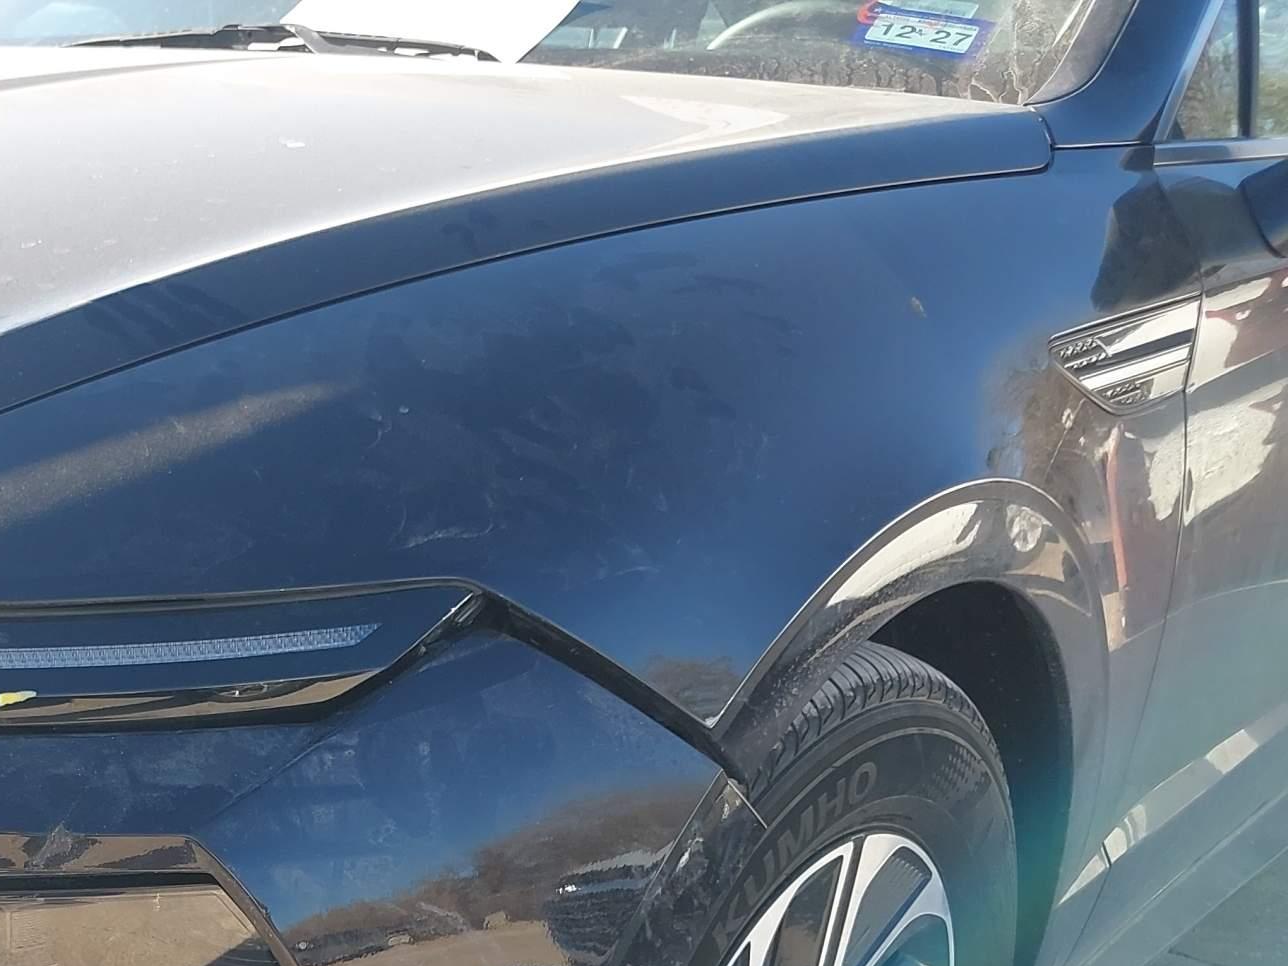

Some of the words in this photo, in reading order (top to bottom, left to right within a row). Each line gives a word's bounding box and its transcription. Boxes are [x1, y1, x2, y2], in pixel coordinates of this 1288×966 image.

[881, 23, 917, 39] 12
[930, 30, 973, 46] 27
[714, 762, 877, 956] KUMHO
